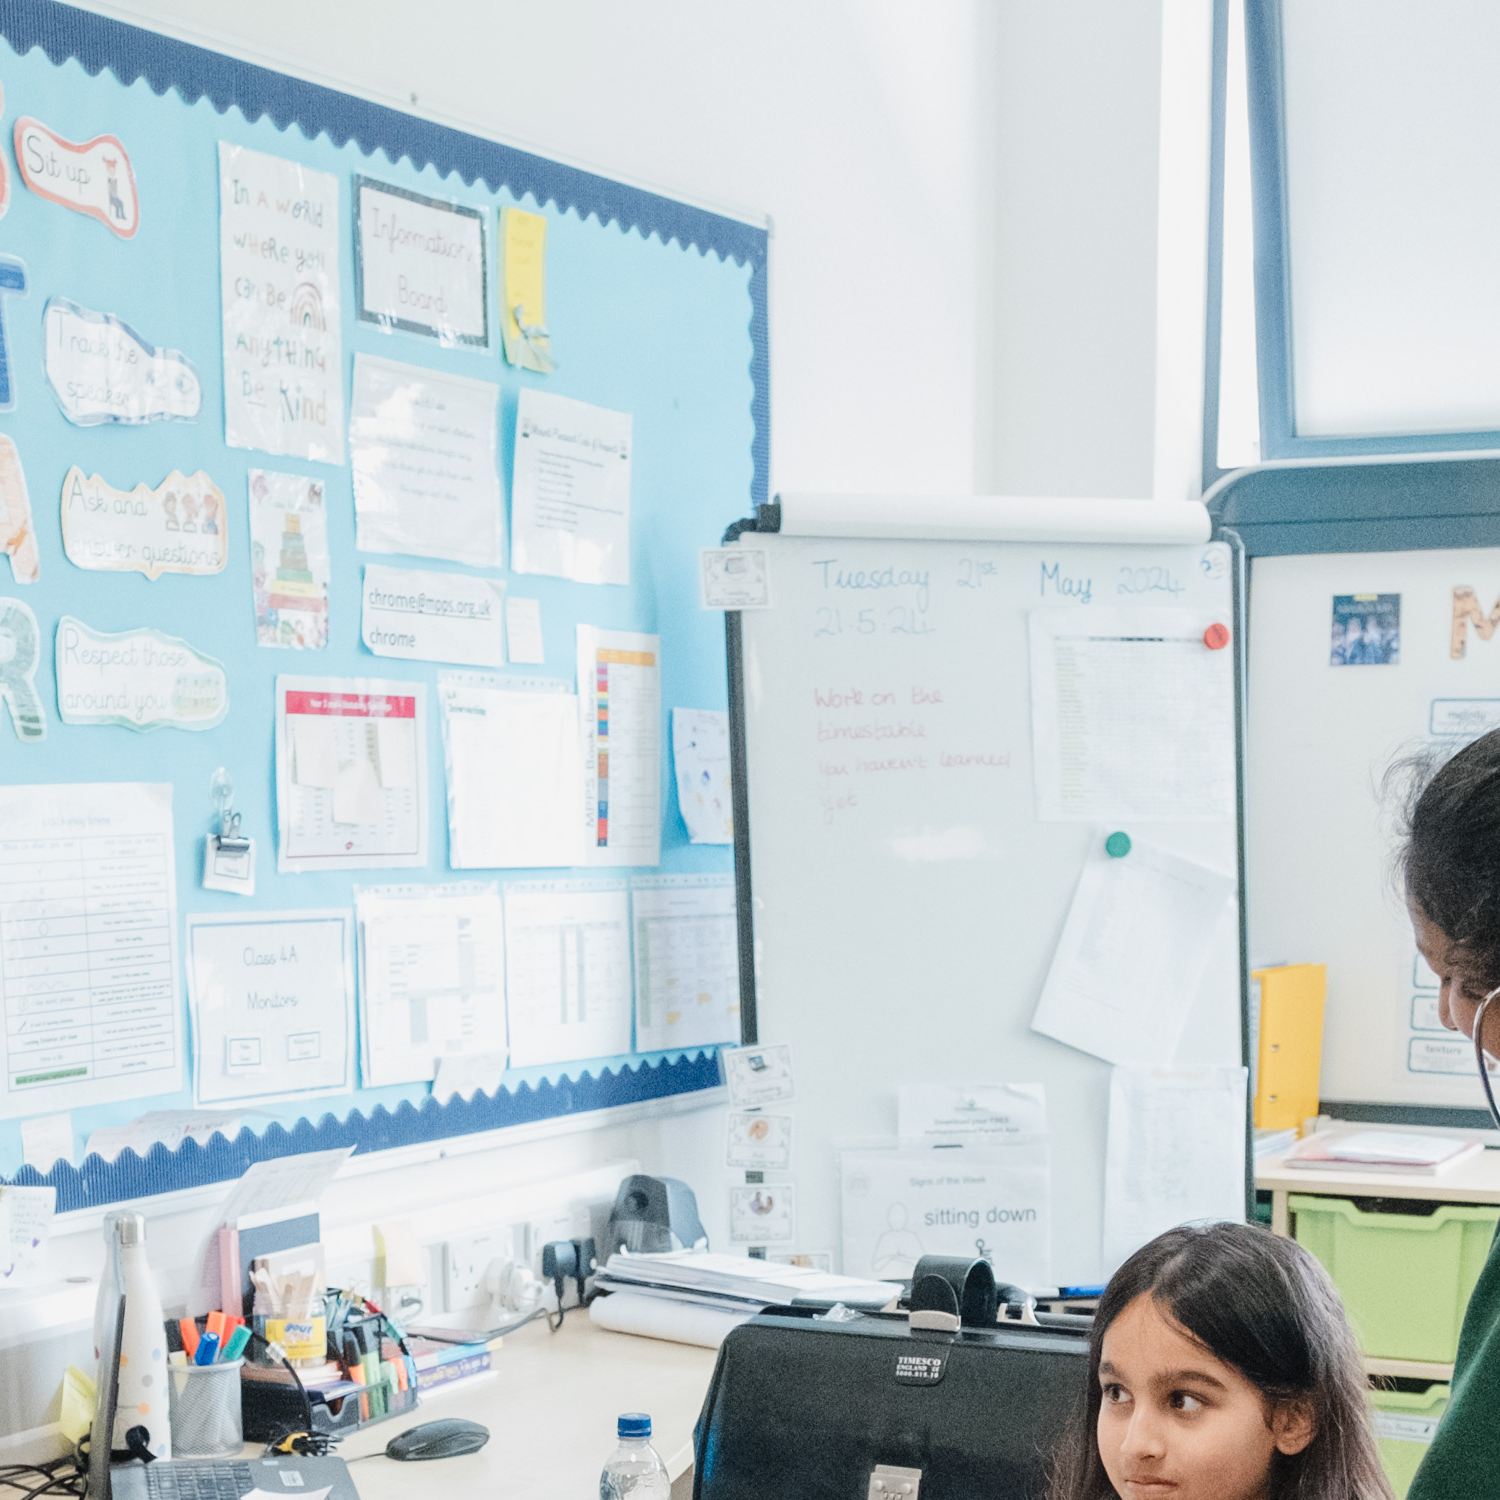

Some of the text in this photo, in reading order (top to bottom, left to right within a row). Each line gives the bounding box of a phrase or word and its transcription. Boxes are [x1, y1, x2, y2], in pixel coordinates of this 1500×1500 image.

[25, 134, 93, 197] Sit up
[371, 205, 474, 263] Information
[397, 273, 449, 314] Board
[68, 474, 149, 517] Ask and
[141, 540, 222, 568] questions
[810, 558, 931, 614] Tuesday
[1039, 560, 1094, 606] May
[1116, 566, 1188, 598] 2024
[367, 587, 493, 619] chrome@mpps.org.uk
[64, 627, 188, 677] Respect those
[368, 628, 417, 649] chrome
[64, 681, 169, 721] around you
[813, 684, 945, 710] Work on the
[819, 760, 850, 790] you
[939, 748, 1013, 770] learned
[820, 790, 860, 826] yet
[242, 946, 277, 967] Class
[247, 989, 299, 1011] Monitors
[909, 1175, 987, 1189] Signs of the Week
[924, 1204, 1038, 1229] sitting down
[895, 1364, 928, 1372] ENGLAND
[898, 1356, 942, 1367] TIMESCO
